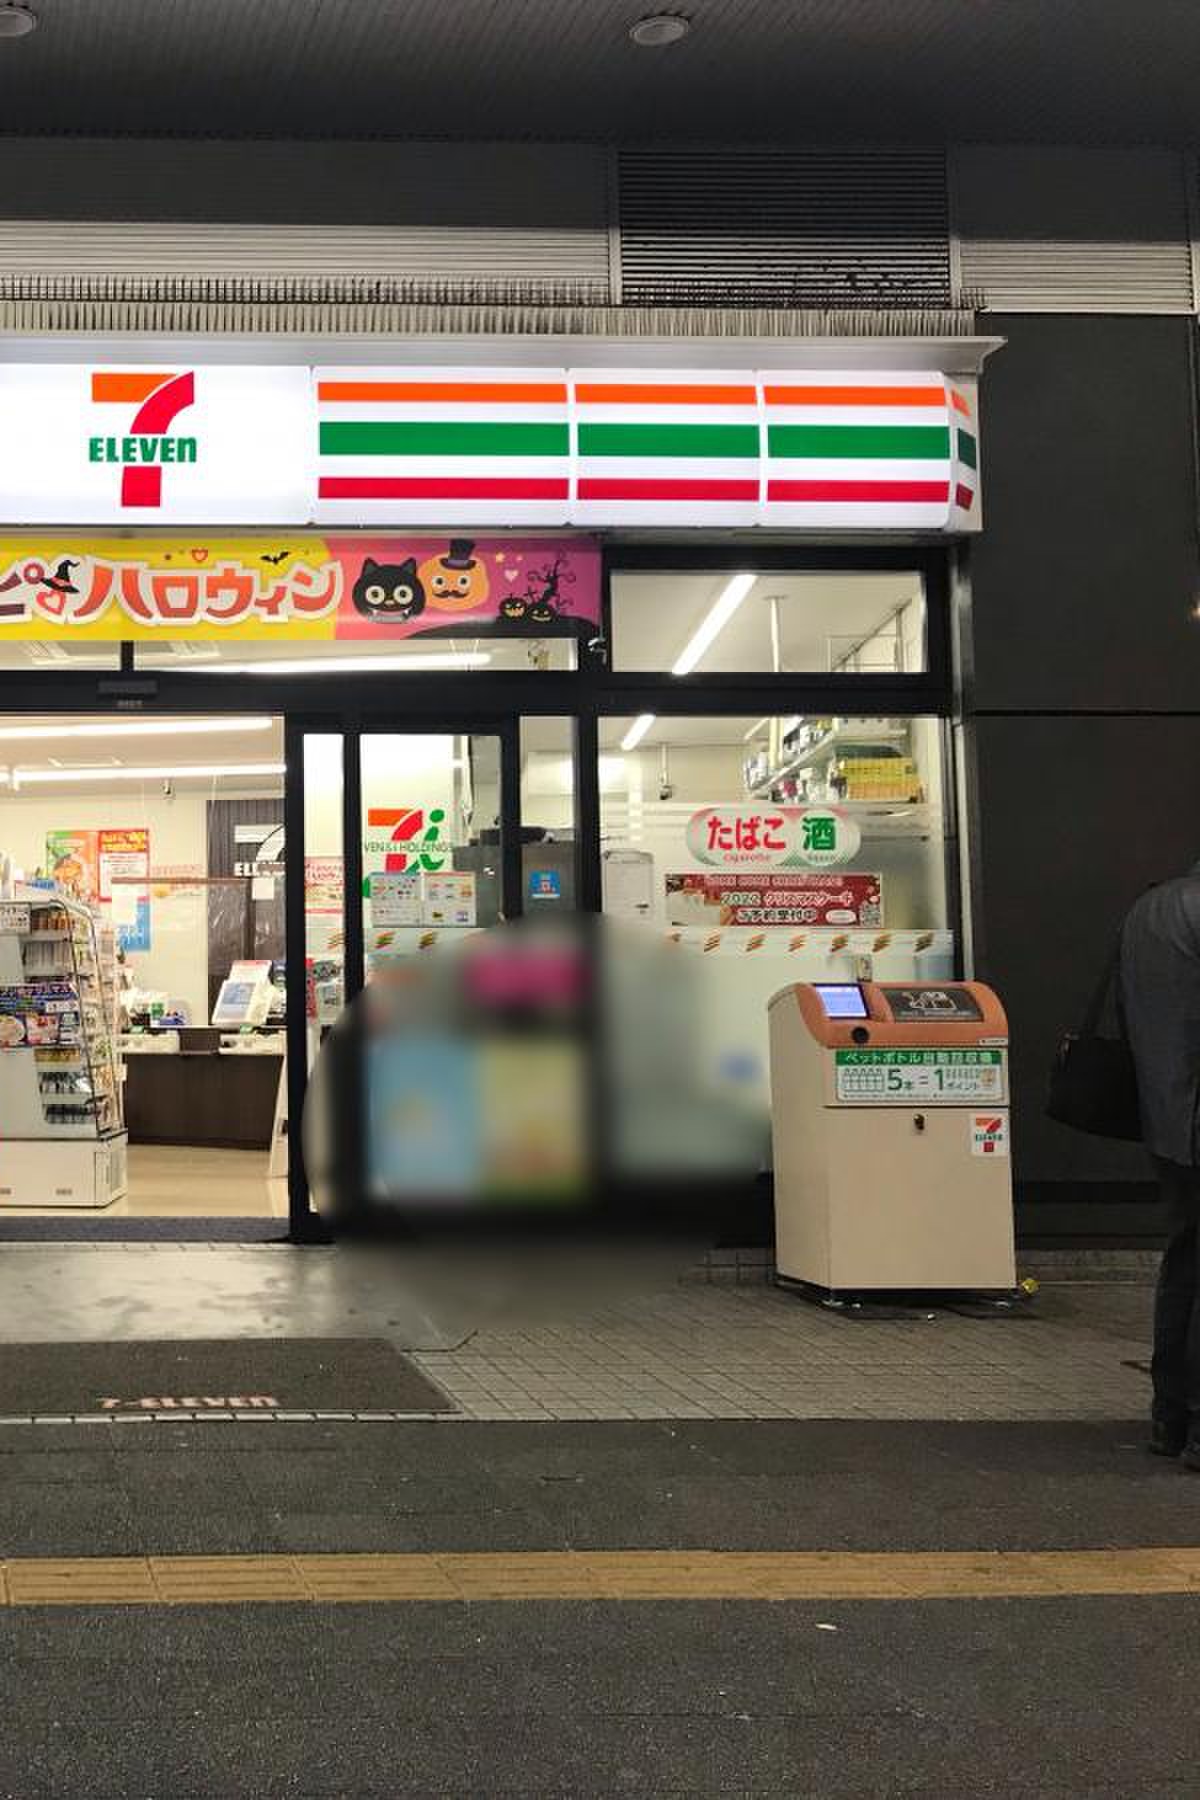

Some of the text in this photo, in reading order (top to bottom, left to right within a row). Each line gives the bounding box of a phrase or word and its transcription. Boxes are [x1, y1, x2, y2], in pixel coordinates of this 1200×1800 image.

[707, 815, 836, 851] たばこ 酒
